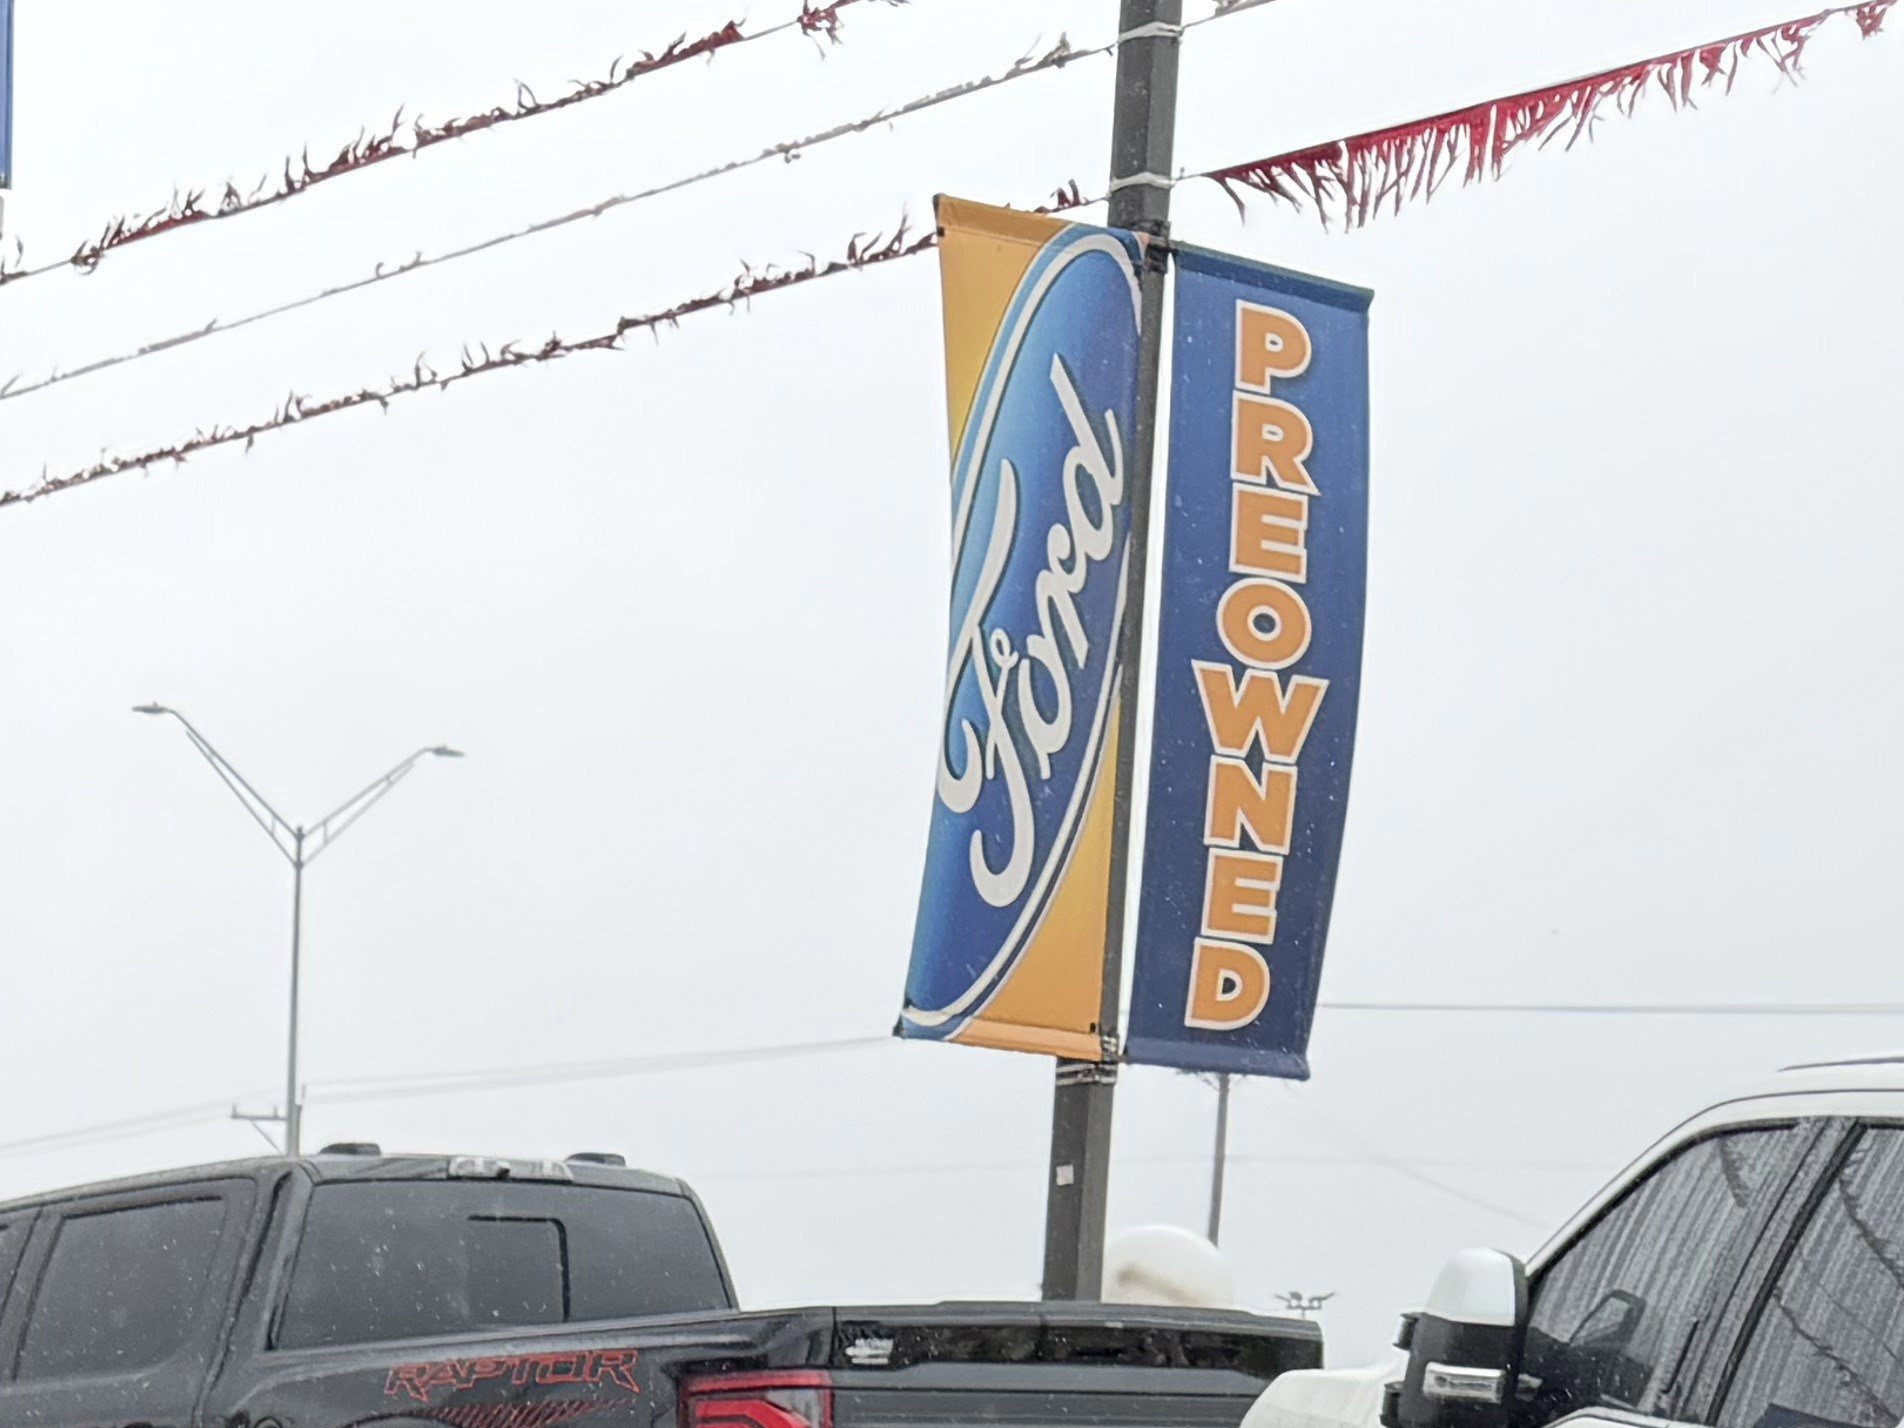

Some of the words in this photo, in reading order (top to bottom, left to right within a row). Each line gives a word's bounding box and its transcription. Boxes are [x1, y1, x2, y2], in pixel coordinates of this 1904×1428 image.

[938, 353, 1130, 907] Ford
[1185, 300, 1330, 1030] PREOWNED
[384, 1348, 641, 1404] RAPTOR
